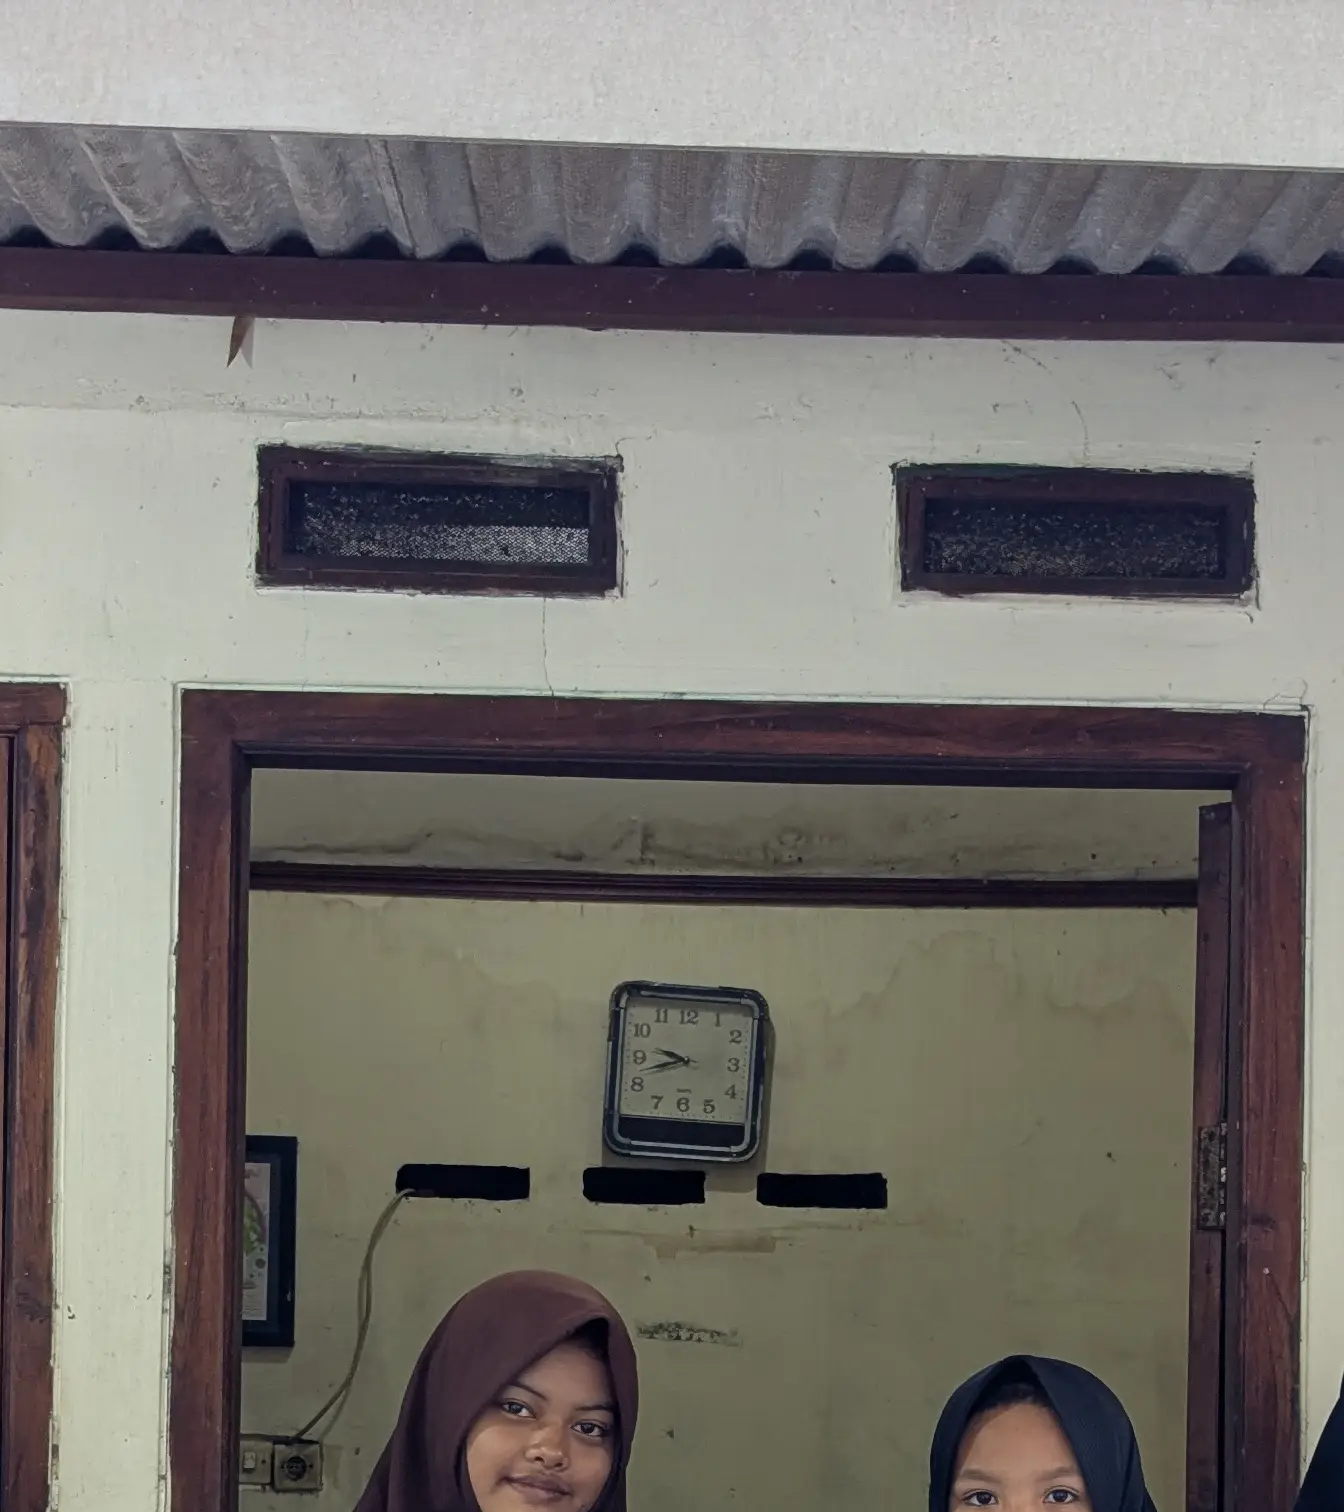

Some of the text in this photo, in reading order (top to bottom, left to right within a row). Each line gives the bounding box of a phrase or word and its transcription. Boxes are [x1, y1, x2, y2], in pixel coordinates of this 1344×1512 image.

[654, 1008, 669, 1024] 11
[679, 1009, 699, 1025] 12
[714, 1013, 722, 1027] 1
[632, 1022, 651, 1039] 10
[729, 1030, 743, 1045] 2
[632, 1050, 647, 1065] 9
[727, 1058, 740, 1073] 3
[630, 1077, 645, 1092] 8
[724, 1084, 738, 1099] 4
[651, 1095, 664, 1110] 7
[676, 1097, 690, 1112] 6
[703, 1099, 716, 1114] 5
